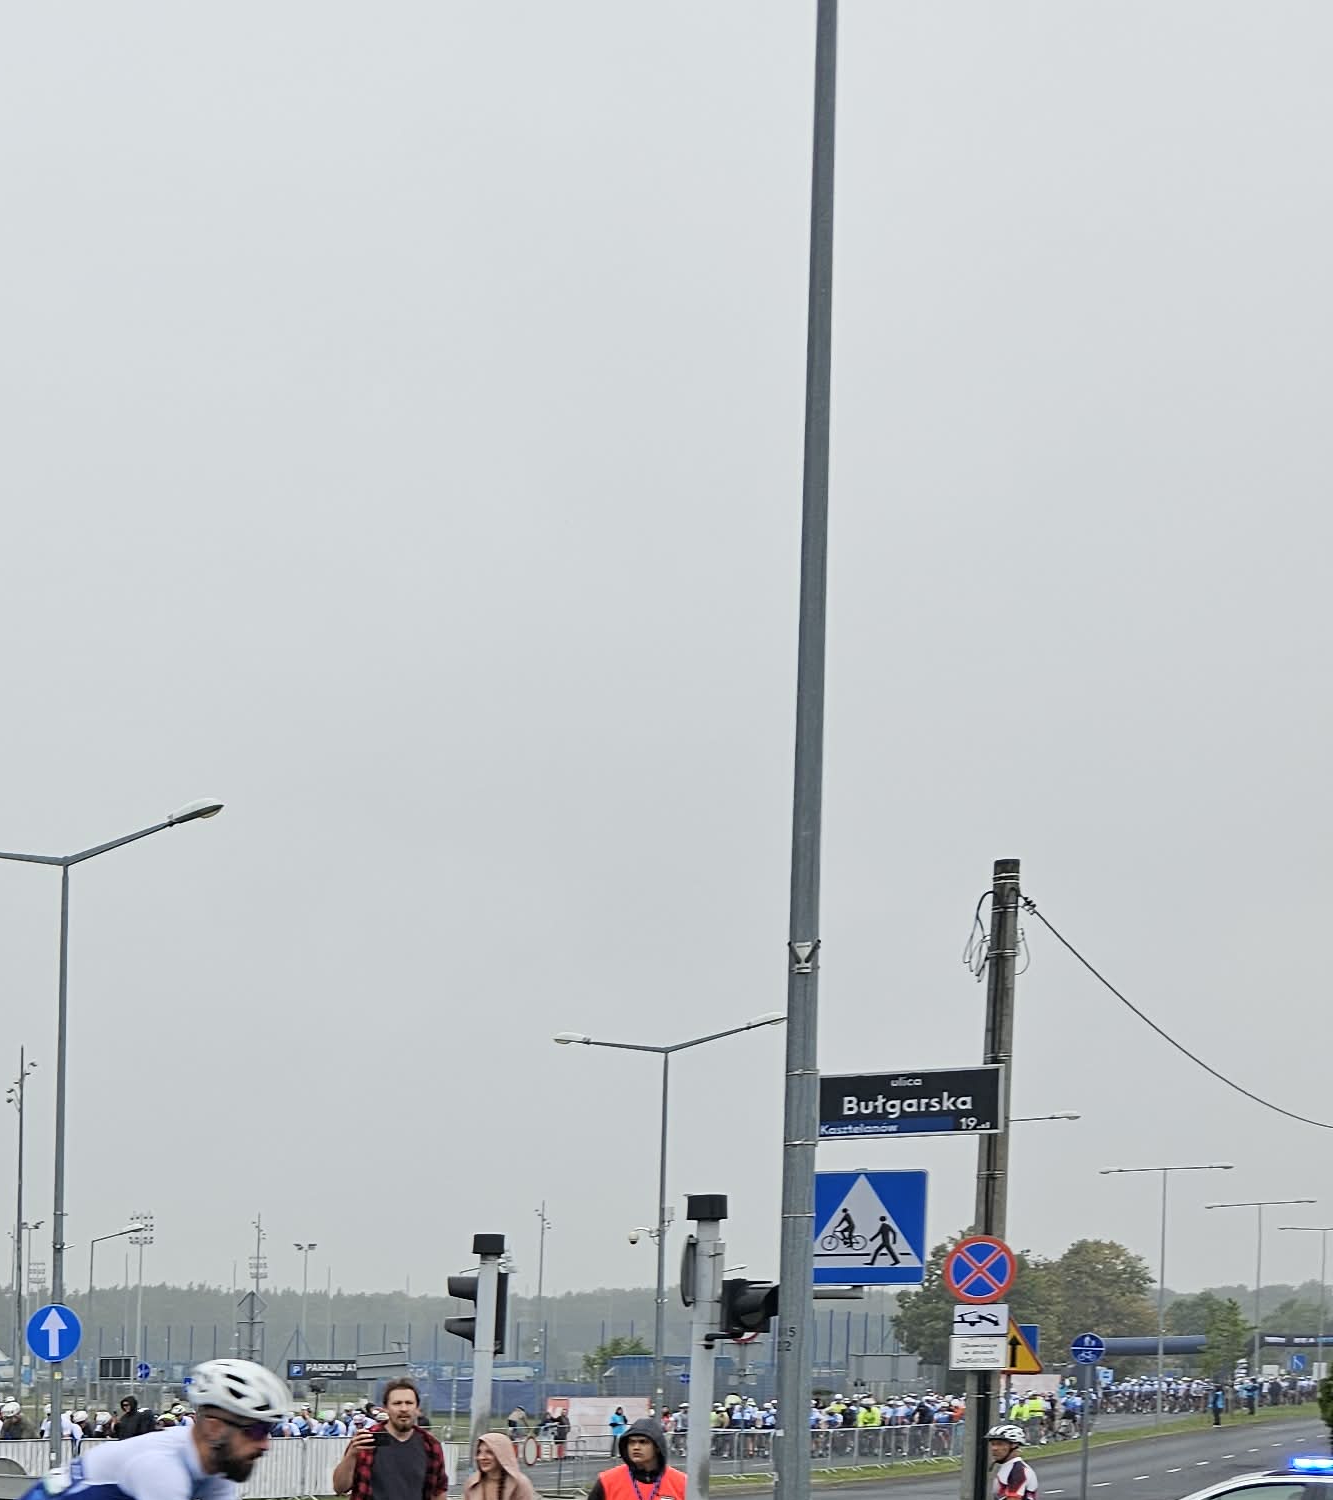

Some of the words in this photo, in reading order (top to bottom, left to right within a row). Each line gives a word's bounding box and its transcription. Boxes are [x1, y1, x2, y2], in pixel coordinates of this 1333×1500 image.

[890, 1077, 922, 1087] ulica
[842, 1091, 973, 1118] Bułgarska
[820, 1123, 899, 1135] Kasztelanów
[305, 1364, 345, 1373] PARKING
